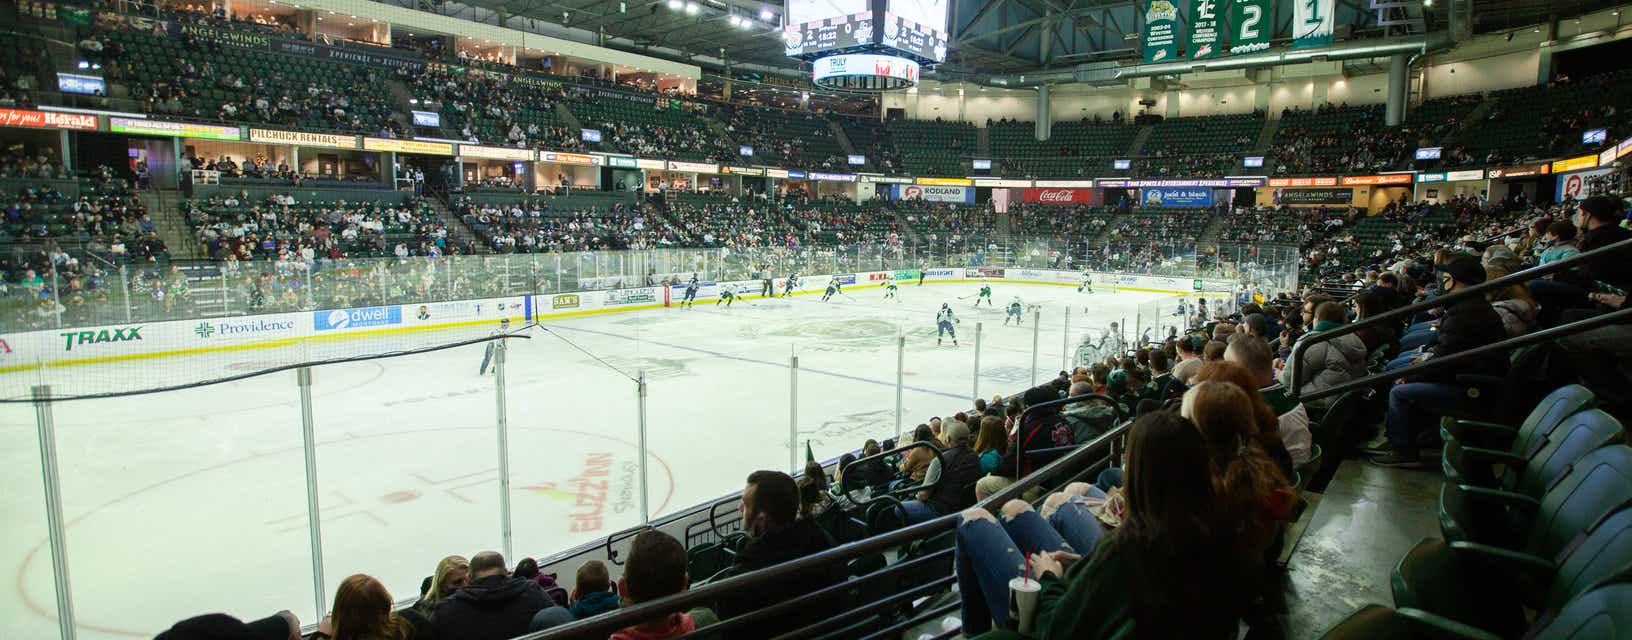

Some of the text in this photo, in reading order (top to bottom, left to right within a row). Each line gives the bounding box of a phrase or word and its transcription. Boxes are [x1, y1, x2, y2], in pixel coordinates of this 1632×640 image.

[1306, 0, 1323, 24] 1
[845, 23, 852, 34] 0
[1240, 4, 1261, 40] 2
[181, 24, 221, 39] ANGEL
[230, 32, 268, 46] WINDS
[806, 30, 813, 40] 2
[901, 27, 907, 37] 2
[928, 36, 934, 47] 0
[829, 58, 848, 68] TRULY
[44, 111, 95, 127] Herald
[250, 130, 338, 144] PILCHUCK RENTALS
[925, 188, 961, 196] RODLAND
[1164, 191, 1179, 199] judd
[351, 308, 388, 322] dwell
[220, 319, 295, 335] Providence
[60, 327, 143, 351] TRAXX
